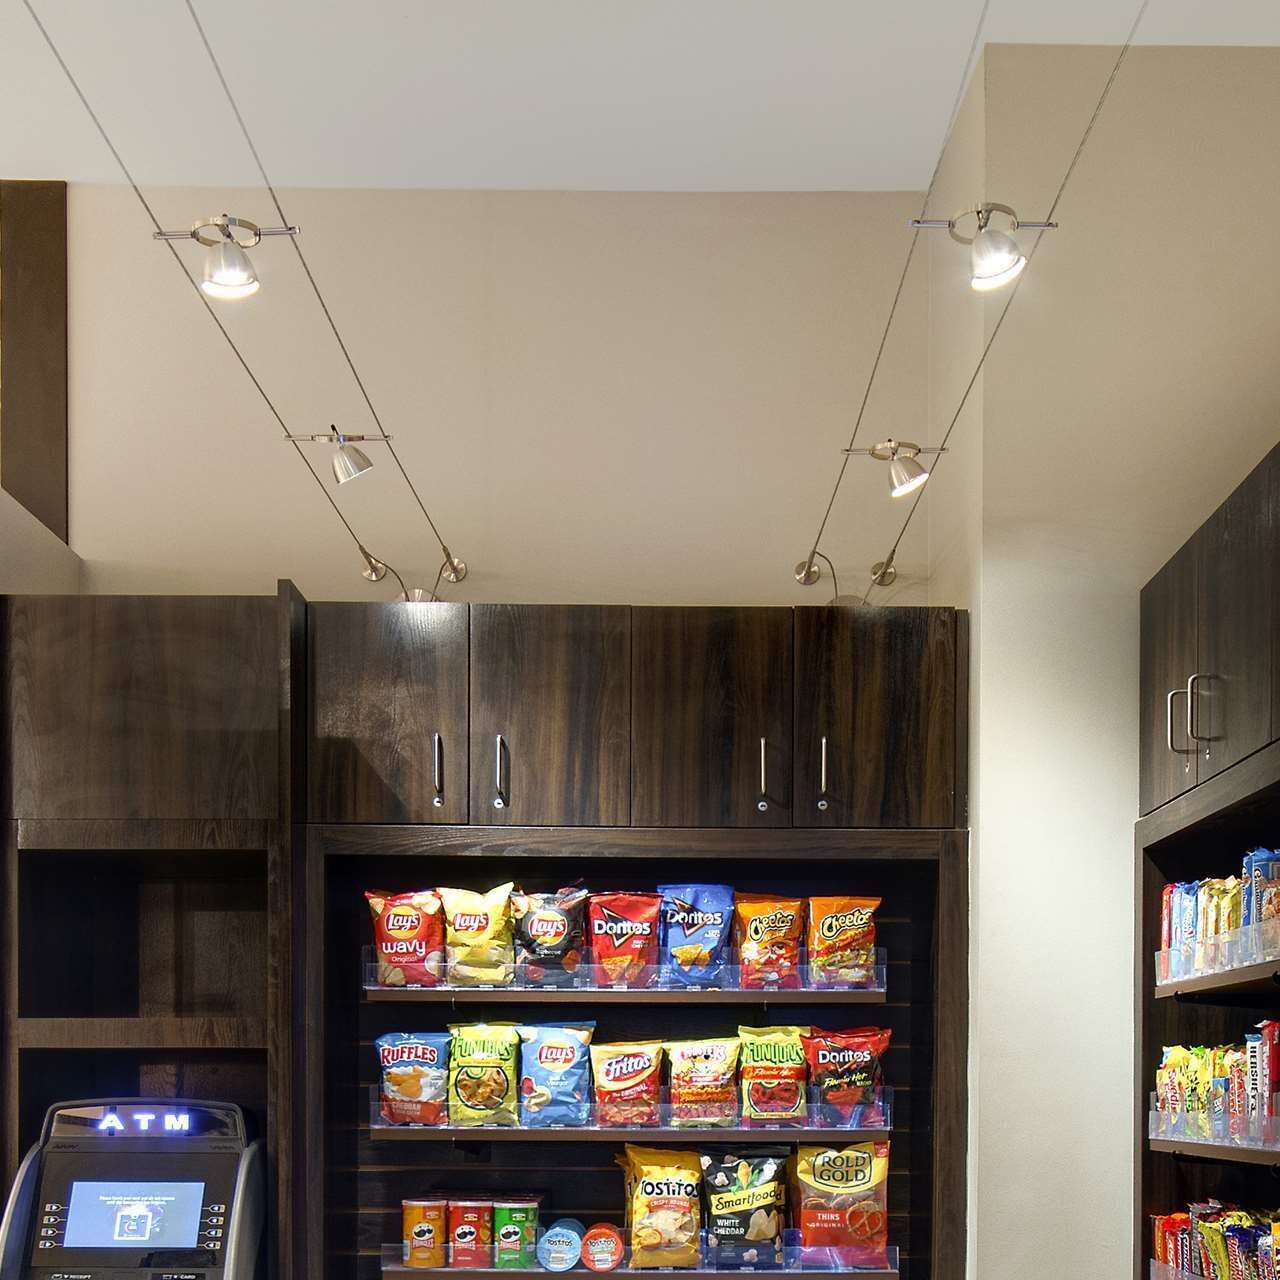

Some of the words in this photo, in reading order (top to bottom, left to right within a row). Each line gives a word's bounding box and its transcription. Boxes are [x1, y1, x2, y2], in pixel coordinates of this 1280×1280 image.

[667, 910, 723, 926] Doritos
[749, 911, 794, 941] Cheetos
[593, 919, 651, 935] Doritos
[382, 940, 426, 957] wavy
[381, 1045, 437, 1066] RUFFLES
[743, 1042, 804, 1065] FUNYUNS
[818, 1050, 871, 1064] Doritos
[603, 1054, 652, 1081] Fritos
[99, 1113, 190, 1131] ATM
[821, 1155, 866, 1170] ROLD
[819, 1168, 866, 1182] GOLD
[714, 1186, 778, 1213] Smartfood
[713, 1226, 745, 1235] CHEDDAR
[716, 1218, 740, 1227] WHITE
